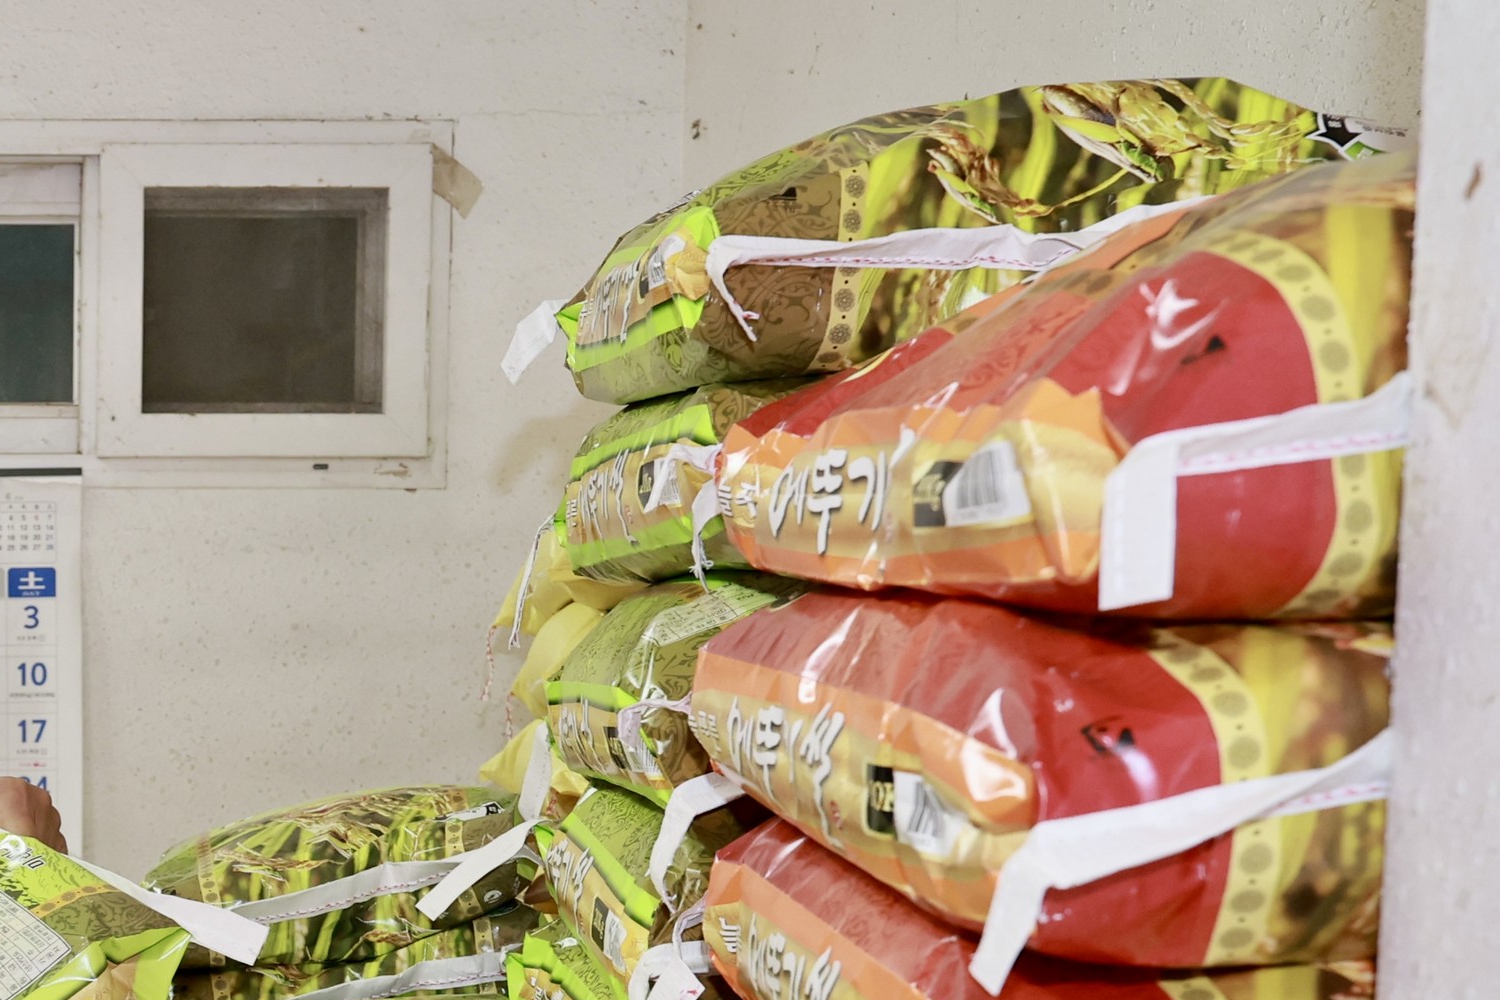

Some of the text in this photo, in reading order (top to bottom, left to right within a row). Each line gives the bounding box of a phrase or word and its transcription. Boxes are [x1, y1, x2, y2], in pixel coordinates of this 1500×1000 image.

[18, 571, 46, 590] 土
[24, 605, 39, 629] 3
[17, 662, 47, 686] 10
[18, 719, 47, 743] 17
